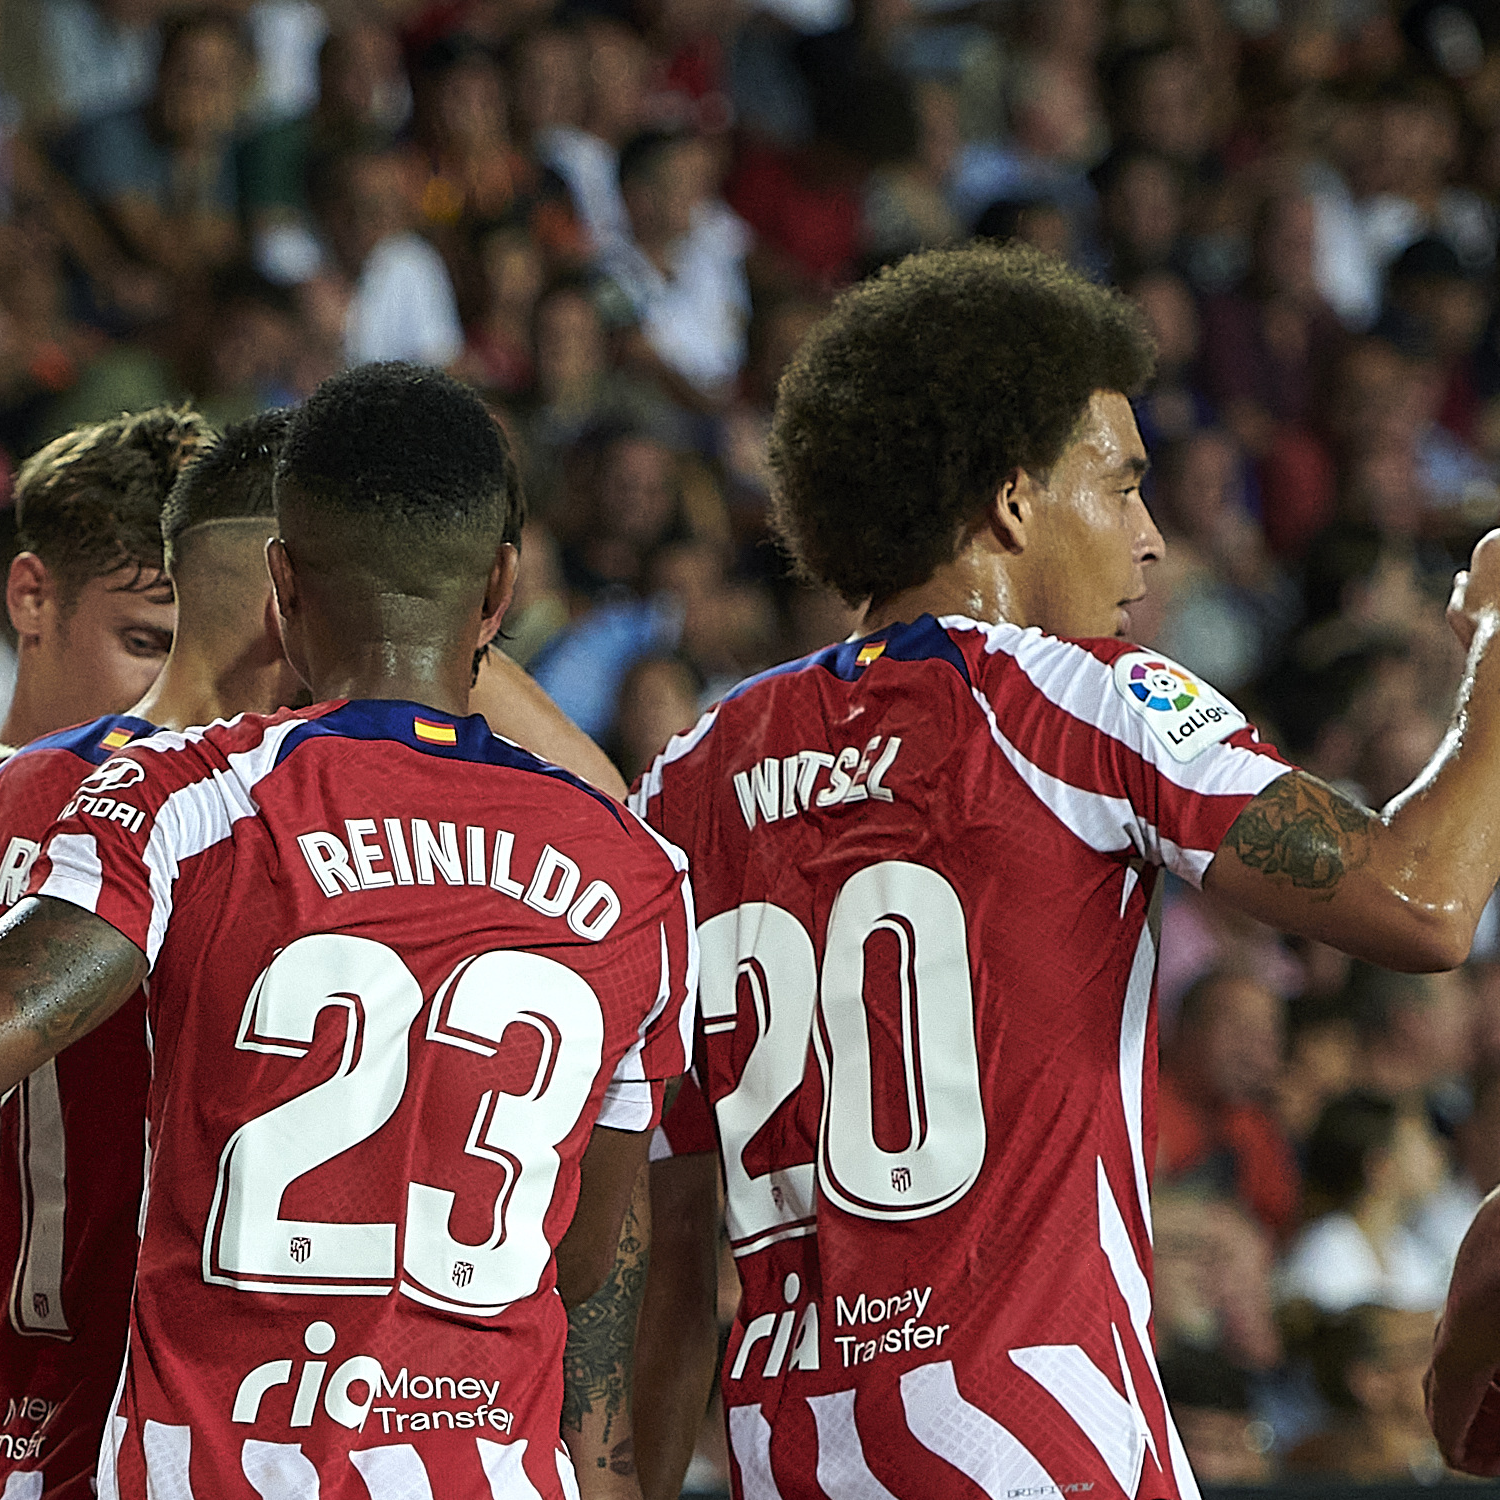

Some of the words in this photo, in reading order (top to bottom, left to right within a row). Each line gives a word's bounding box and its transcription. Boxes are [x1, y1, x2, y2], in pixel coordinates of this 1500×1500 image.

[733, 735, 902, 831] WITSEL
[298, 817, 622, 942] REINILDO
[698, 860, 987, 1257] 20
[203, 933, 605, 1317] 23
[835, 1286, 932, 1327] Money
[374, 1367, 500, 1405] Money
